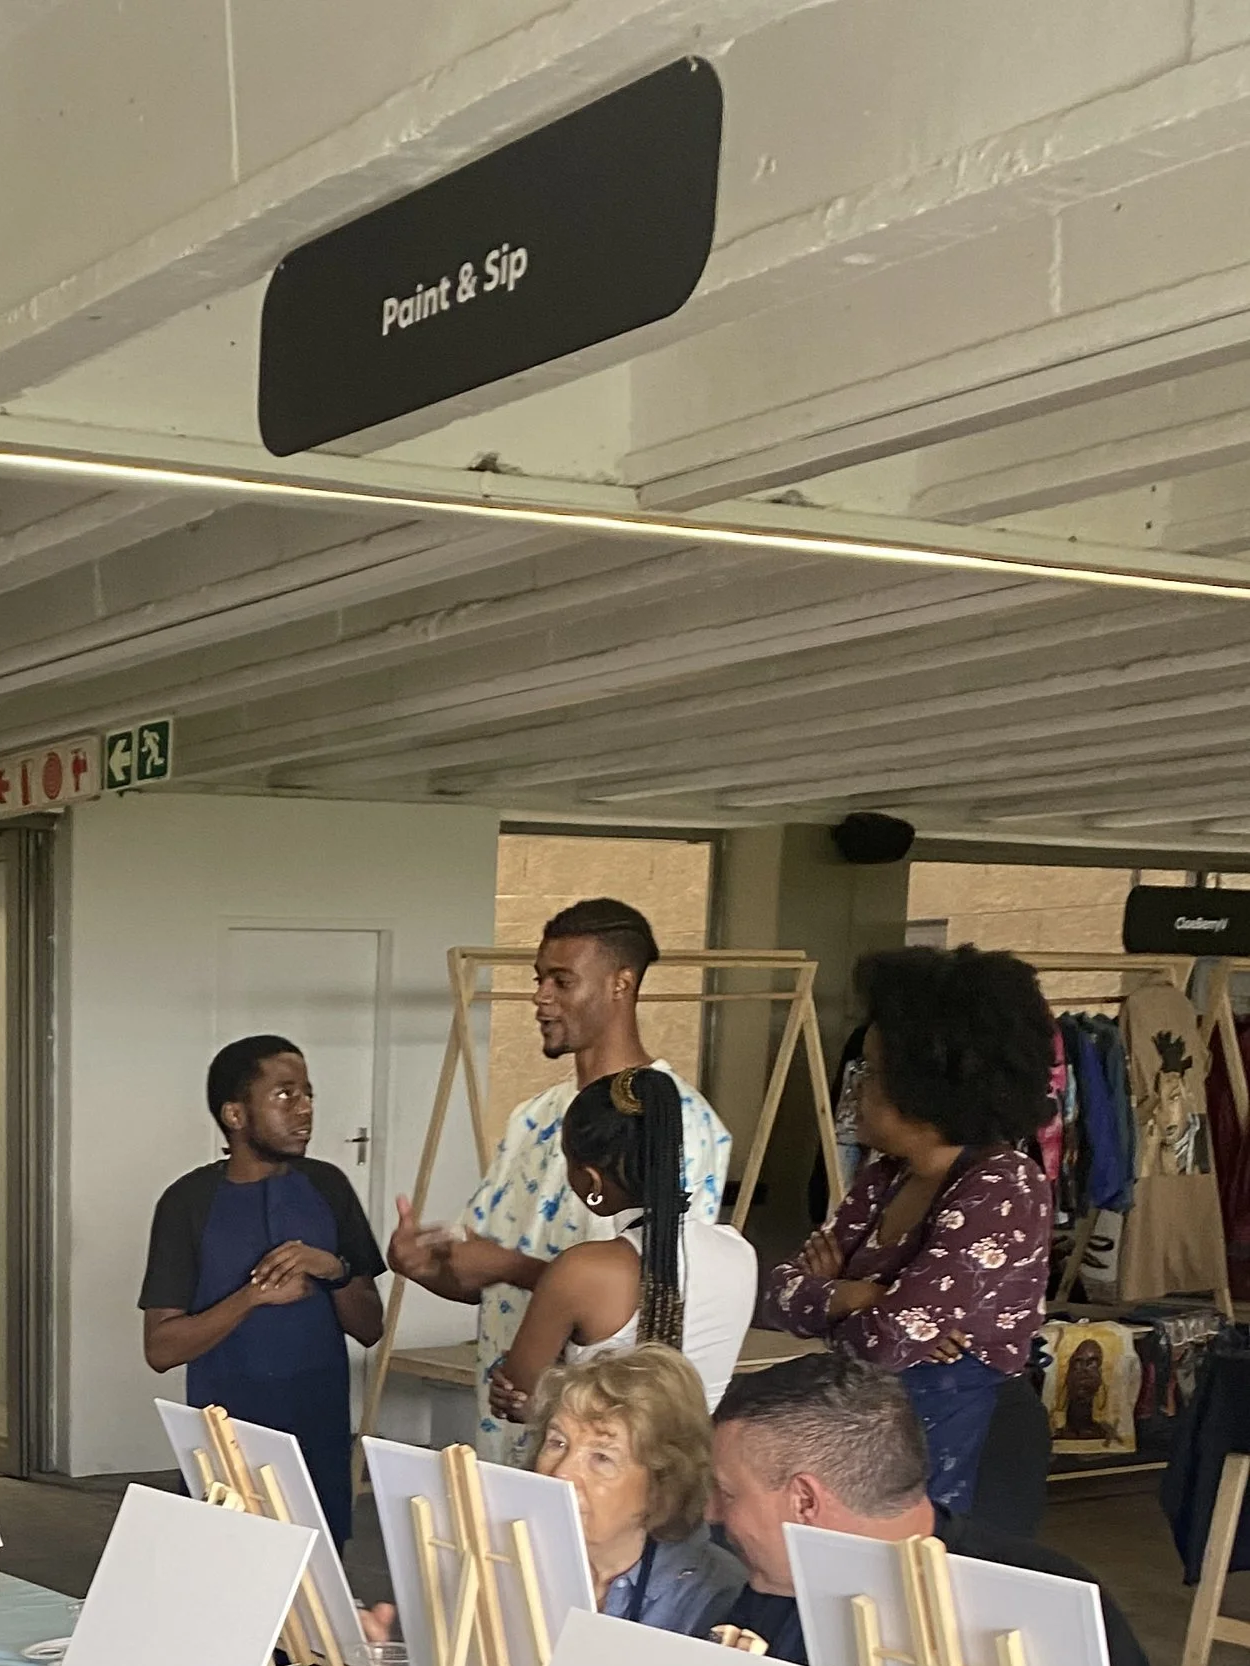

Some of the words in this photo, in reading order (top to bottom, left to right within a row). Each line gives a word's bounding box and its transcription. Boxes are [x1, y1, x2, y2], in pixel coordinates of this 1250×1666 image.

[382, 276, 451, 336] Paint
[456, 262, 478, 303] &
[483, 243, 528, 291] Sip
